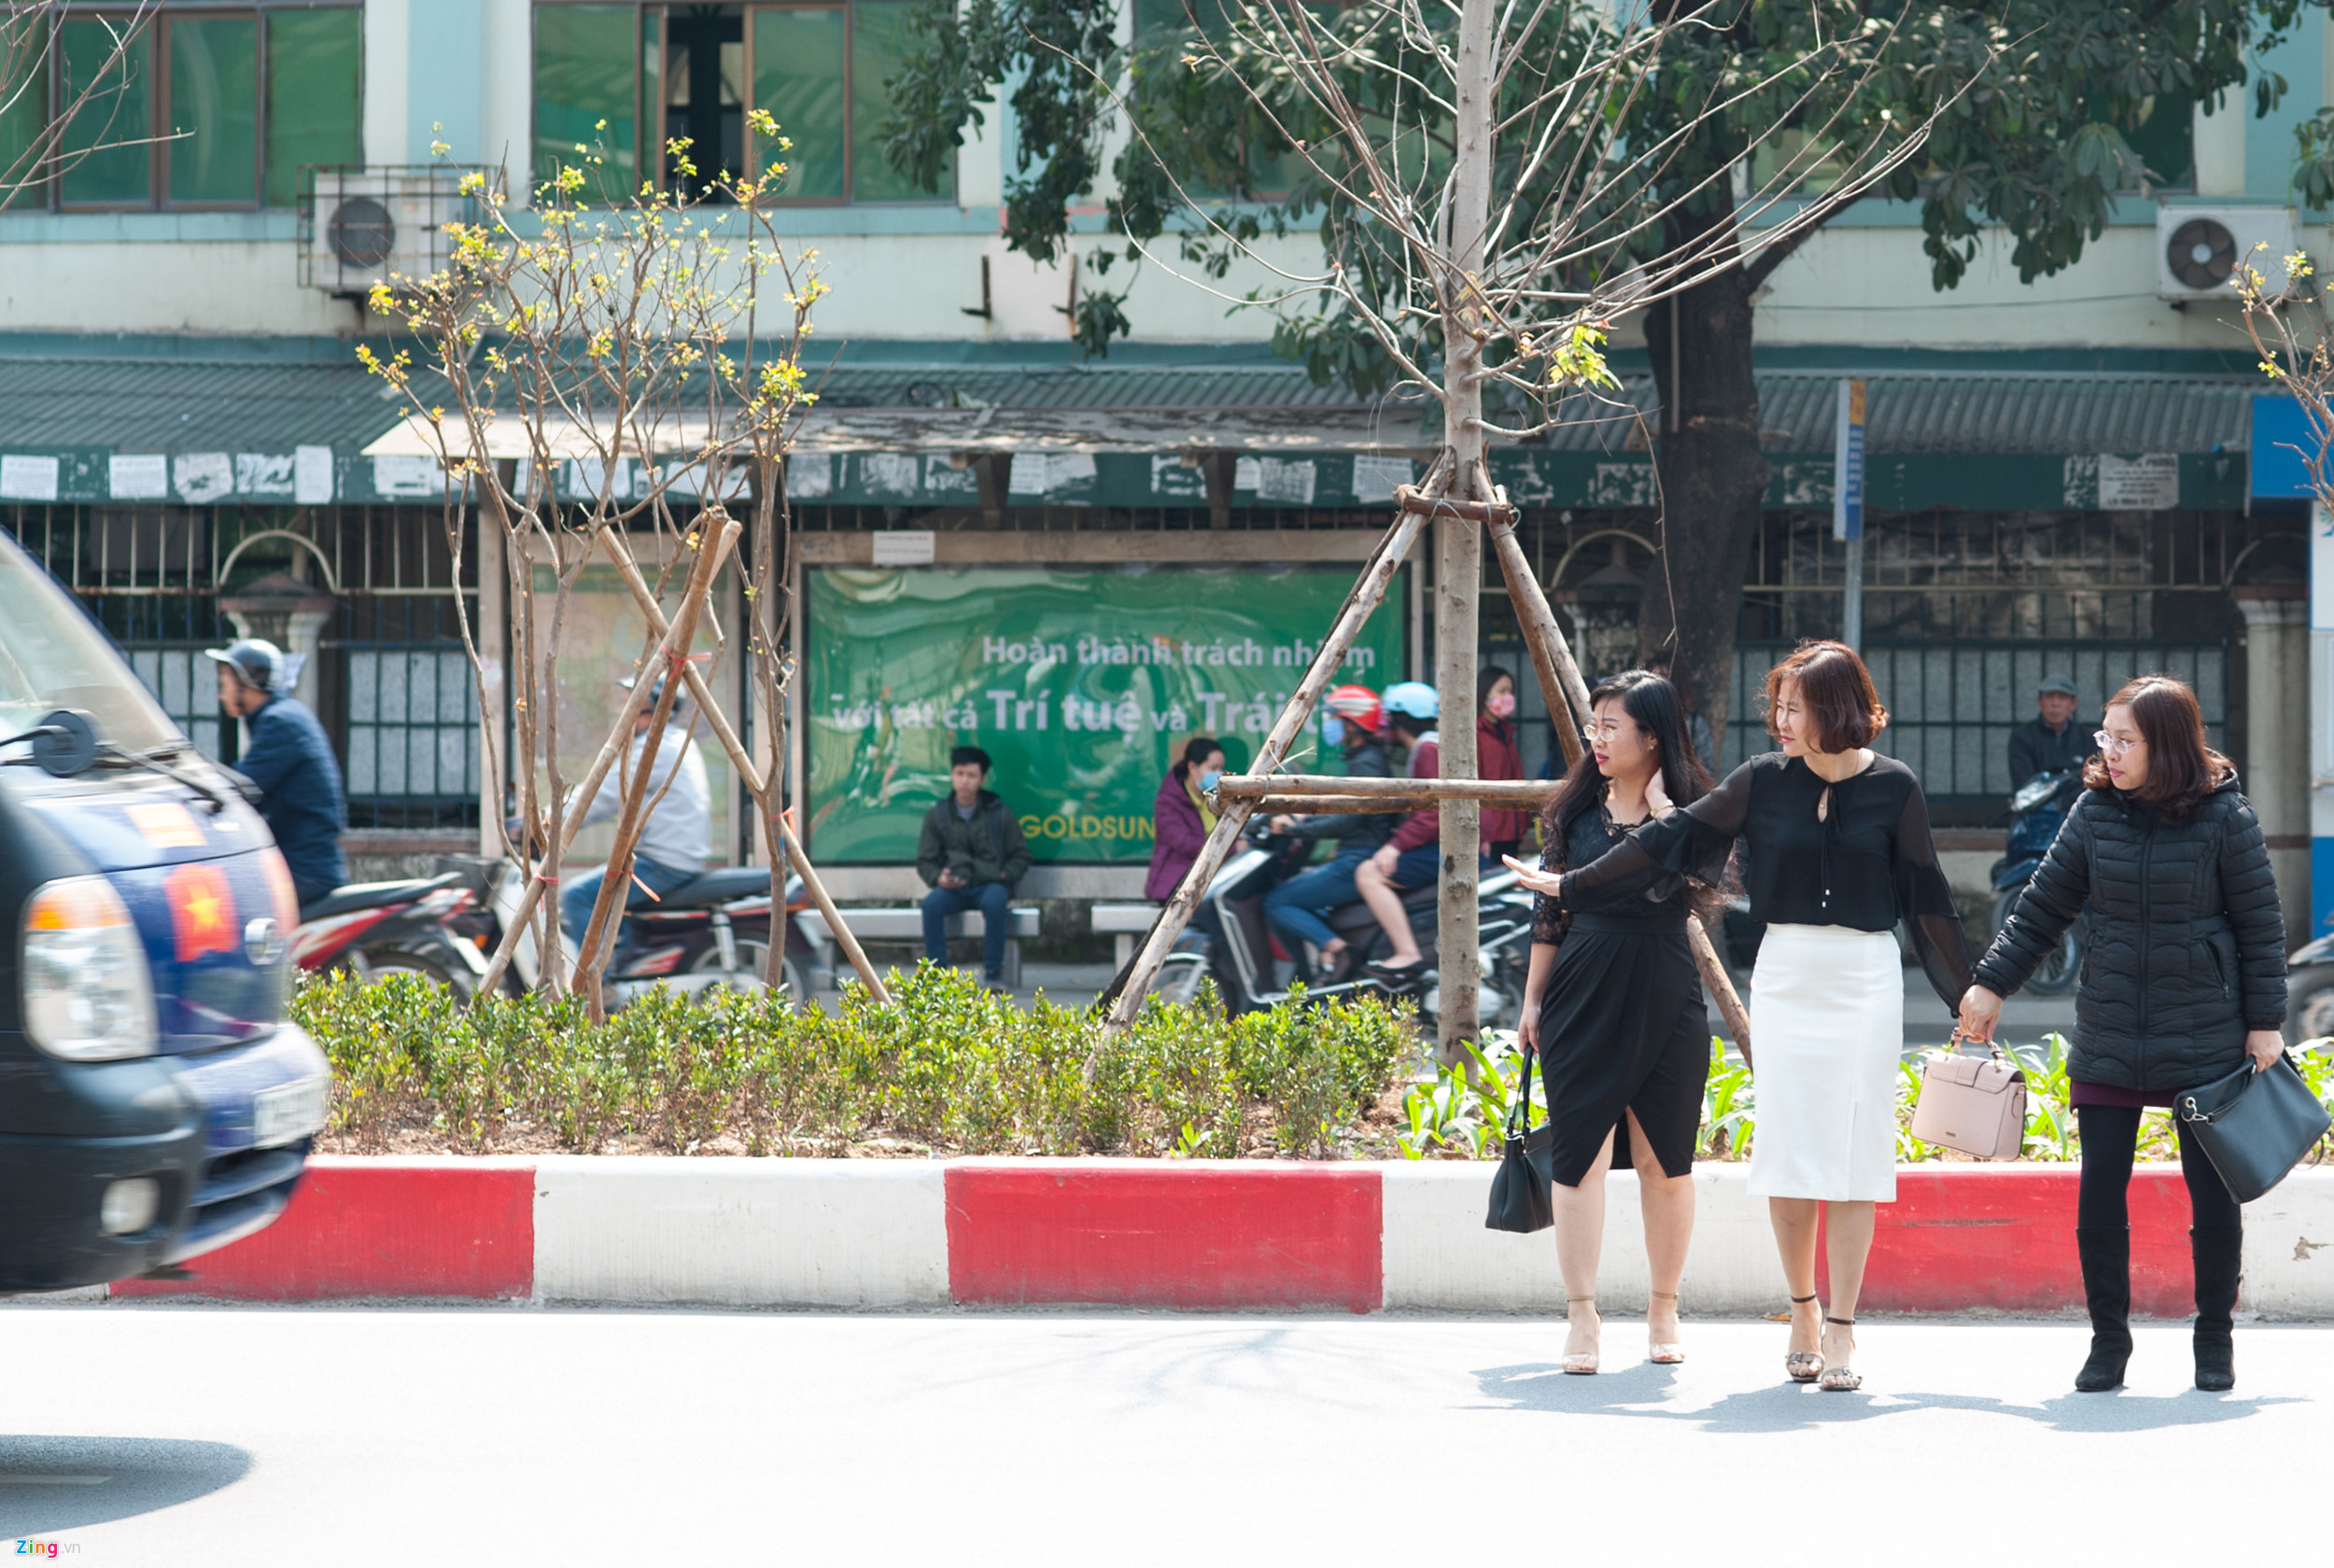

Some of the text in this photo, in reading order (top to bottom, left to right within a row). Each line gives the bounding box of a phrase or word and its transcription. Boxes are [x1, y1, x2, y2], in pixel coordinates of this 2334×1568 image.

[983, 636, 1375, 667] Hoàn thành trách nhm
[832, 700, 882, 729] với
[942, 700, 978, 730] cả
[986, 690, 1051, 731] Trí
[1061, 690, 1143, 744] tuệ
[1150, 704, 1188, 732] và
[1018, 814, 1156, 839] GOLDSUN
